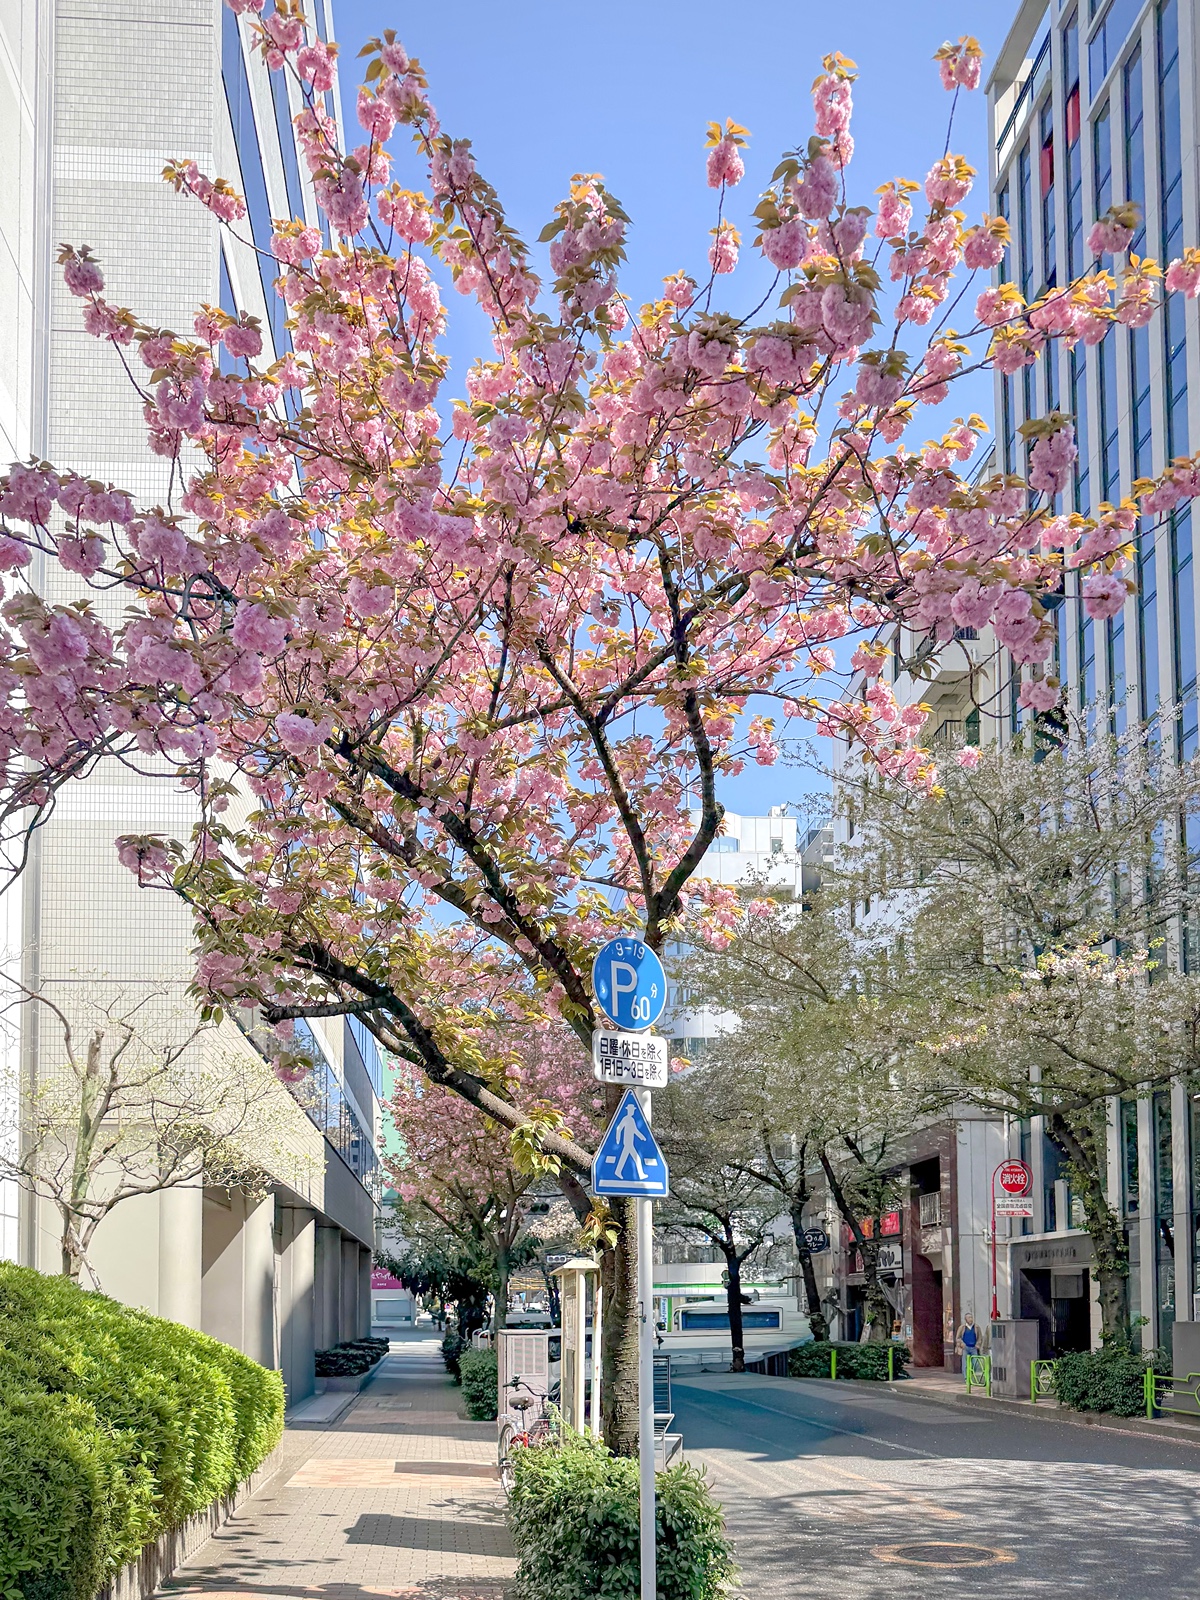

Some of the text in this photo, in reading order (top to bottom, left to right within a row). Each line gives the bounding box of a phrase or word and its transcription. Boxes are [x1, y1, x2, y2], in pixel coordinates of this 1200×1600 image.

[615, 942, 645, 960] 9-19
[610, 960, 638, 1017] P
[1002, 1173, 1026, 1185] 消火栓
